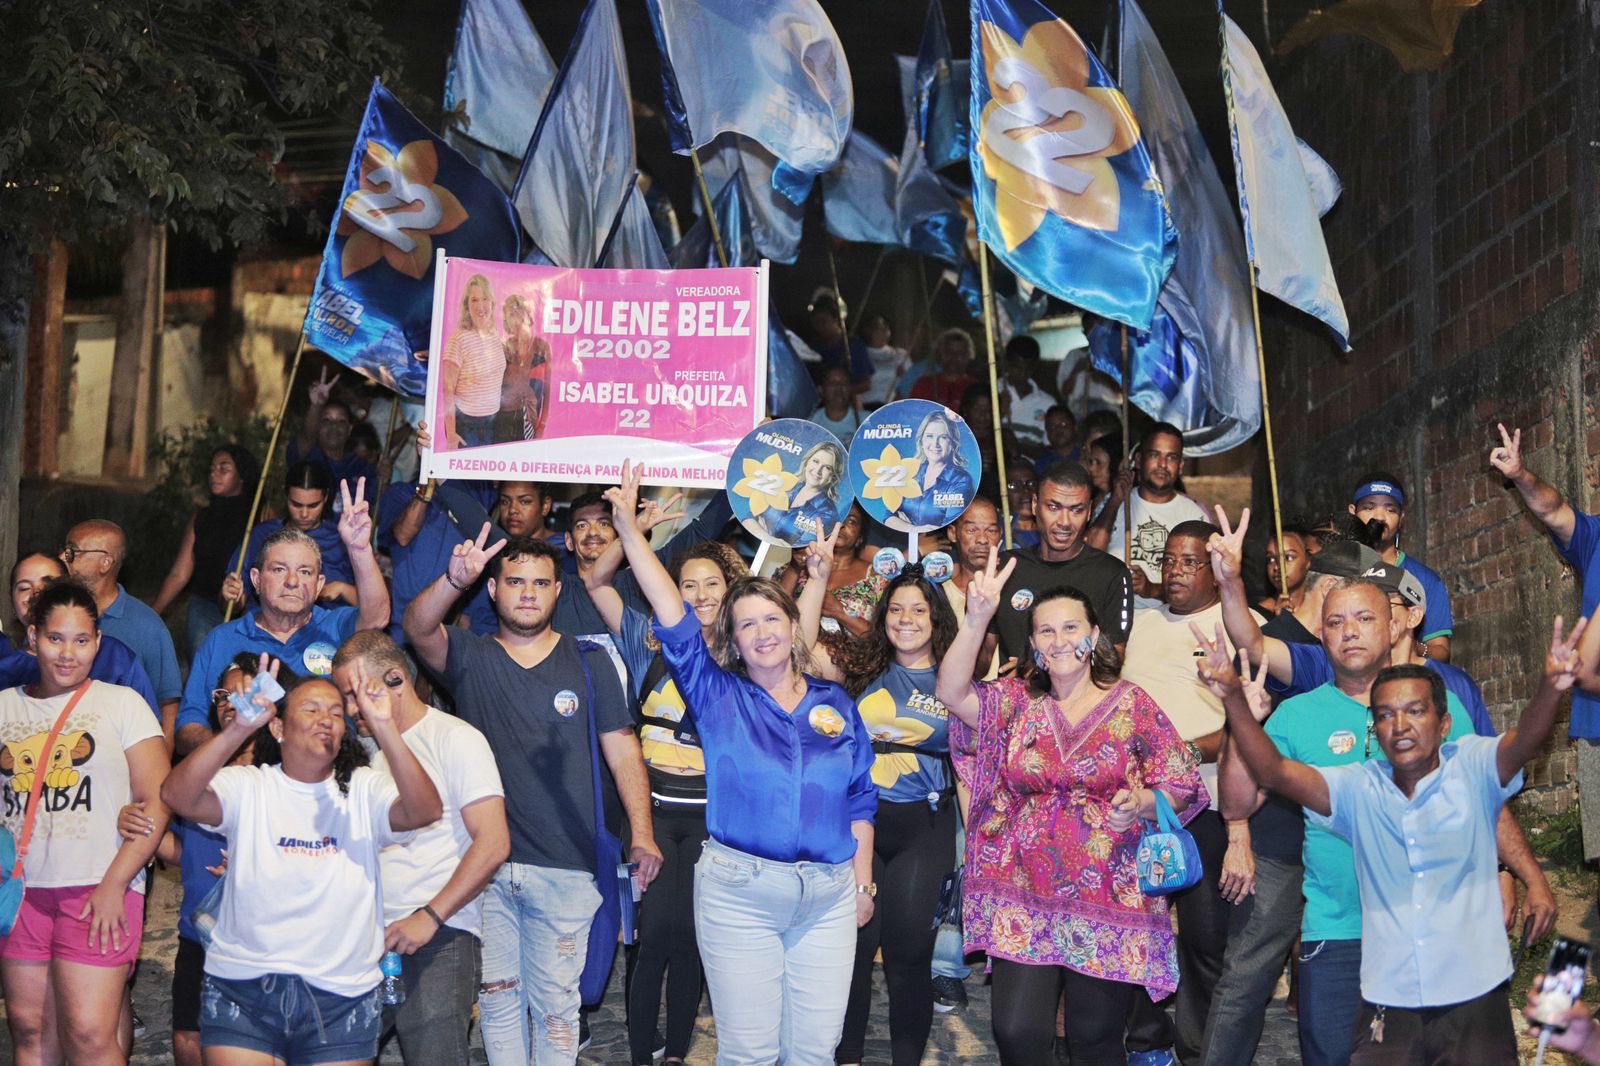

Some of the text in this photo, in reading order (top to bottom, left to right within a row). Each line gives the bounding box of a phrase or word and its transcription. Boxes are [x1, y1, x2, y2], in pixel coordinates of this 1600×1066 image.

[984, 56, 1117, 196] 22
[343, 166, 443, 253] 22
[675, 286, 741, 297] VEREADORA
[543, 299, 751, 337] EDILENE BELZ
[576, 338, 671, 359] 22002
[674, 370, 726, 382] PREFEITA
[558, 381, 748, 407] ISABEL URQUIZA
[618, 408, 651, 428] 22
[755, 431, 803, 456] MUDAR
[863, 427, 913, 440] MUDAR
[448, 458, 507, 472] FAZENDO
[509, 461, 518, 472] A
[521, 461, 592, 477] DIFERENÇA
[595, 464, 624, 477] PAR
[682, 468, 725, 480] MELHO
[874, 465, 908, 487] 22
[746, 470, 785, 496] 22
